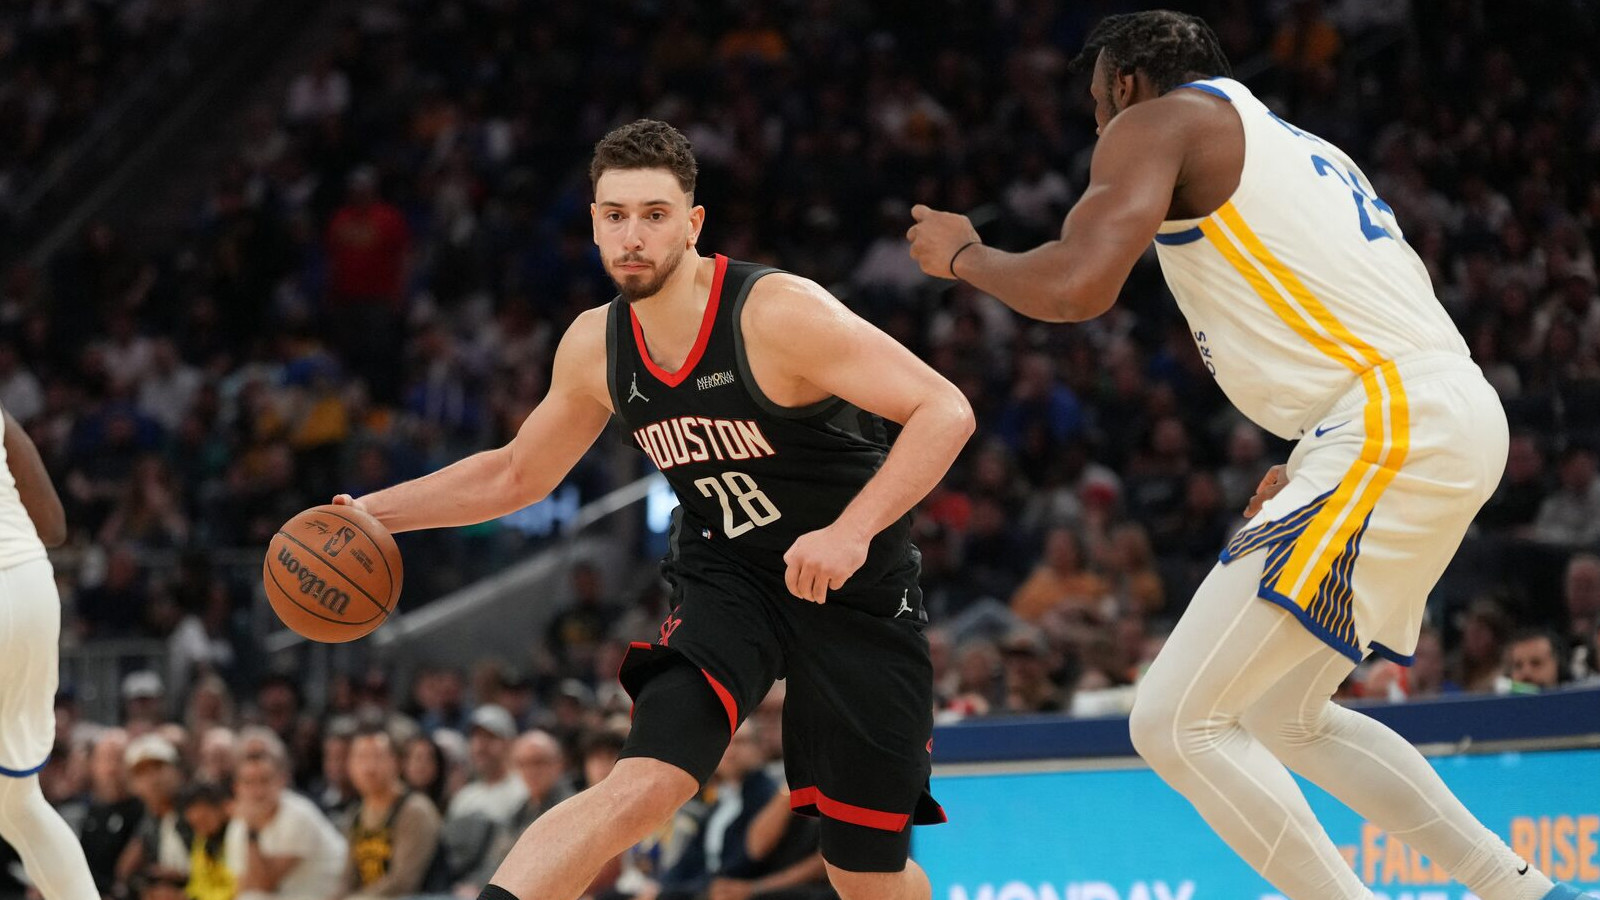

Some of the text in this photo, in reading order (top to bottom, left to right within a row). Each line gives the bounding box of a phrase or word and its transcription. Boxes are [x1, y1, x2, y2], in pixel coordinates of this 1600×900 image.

[697, 370, 733, 384] MEMORIAL
[698, 376, 735, 390] HERMANN
[633, 416, 776, 470] HOUSTON
[694, 471, 782, 539] 28
[277, 545, 350, 615] Wilson
[1511, 815, 1599, 881] RISE
